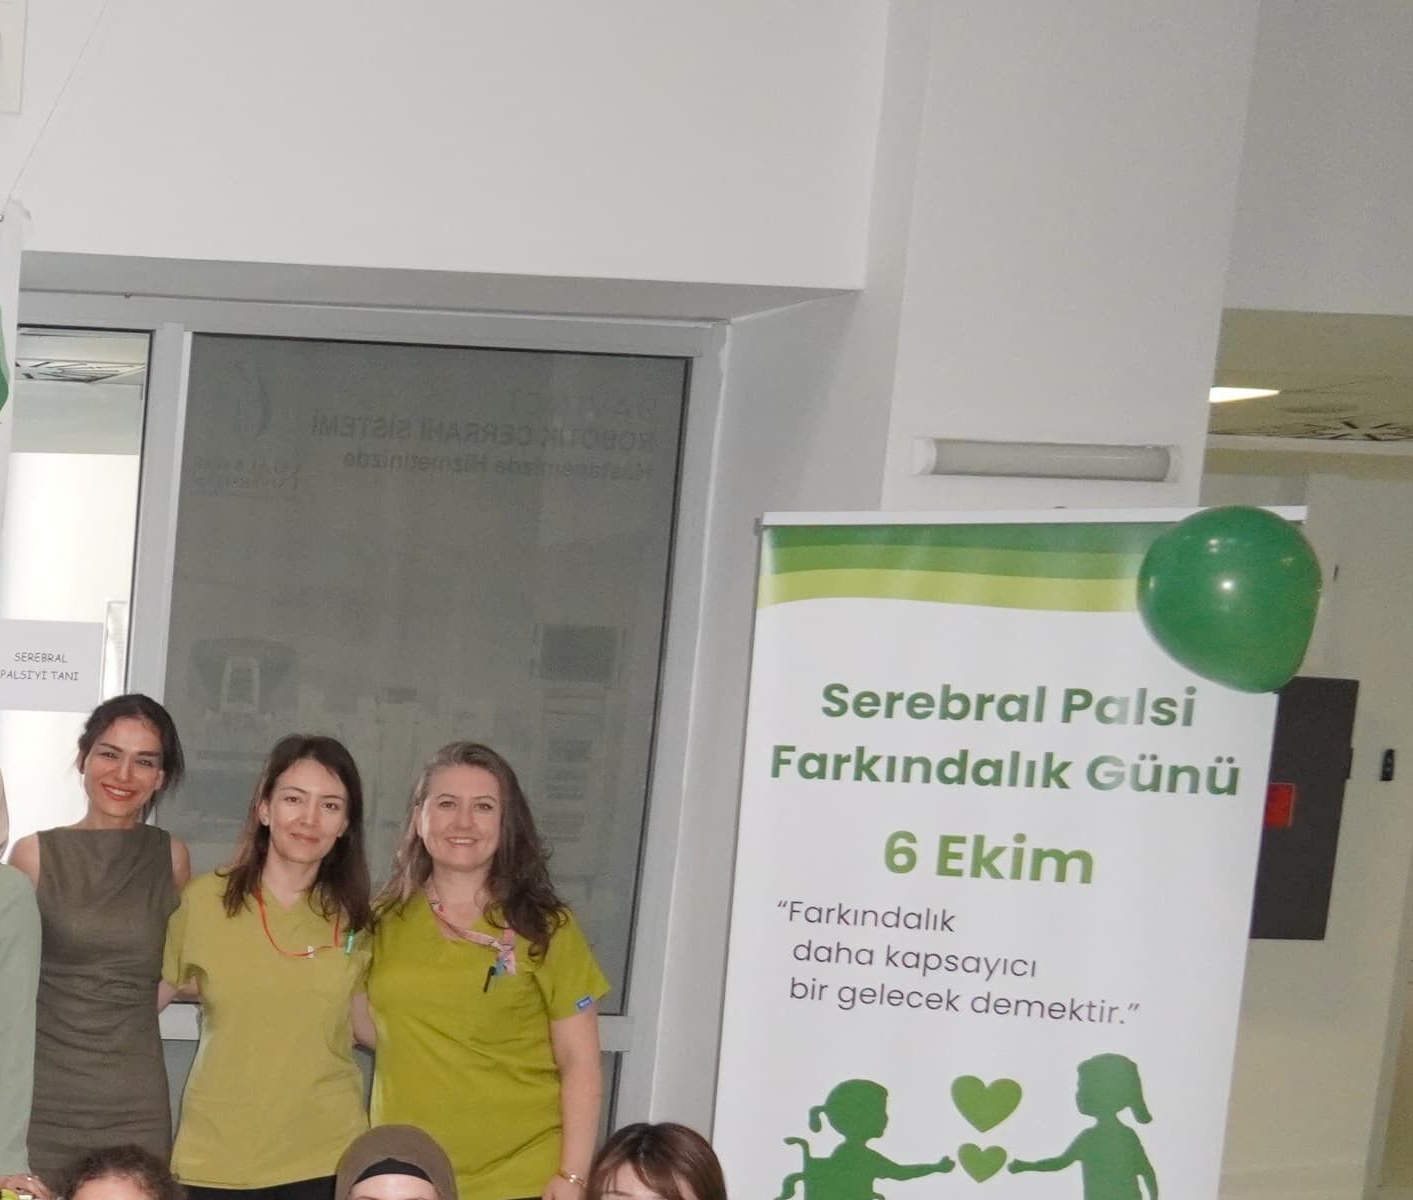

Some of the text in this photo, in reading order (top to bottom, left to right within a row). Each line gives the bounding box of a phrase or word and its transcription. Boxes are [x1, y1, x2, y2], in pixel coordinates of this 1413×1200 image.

[14, 651, 69, 664] SEREBRAL
[51, 671, 79, 681] TANI
[820, 682, 1198, 728] Serebral Palsi
[770, 744, 1242, 797] Farkındalık Günü
[884, 830, 1095, 886] 6 Ekim
[792, 939, 1037, 981] daha kapsayıcı
[789, 976, 829, 1003] bir
[837, 979, 961, 1012] gelecek
